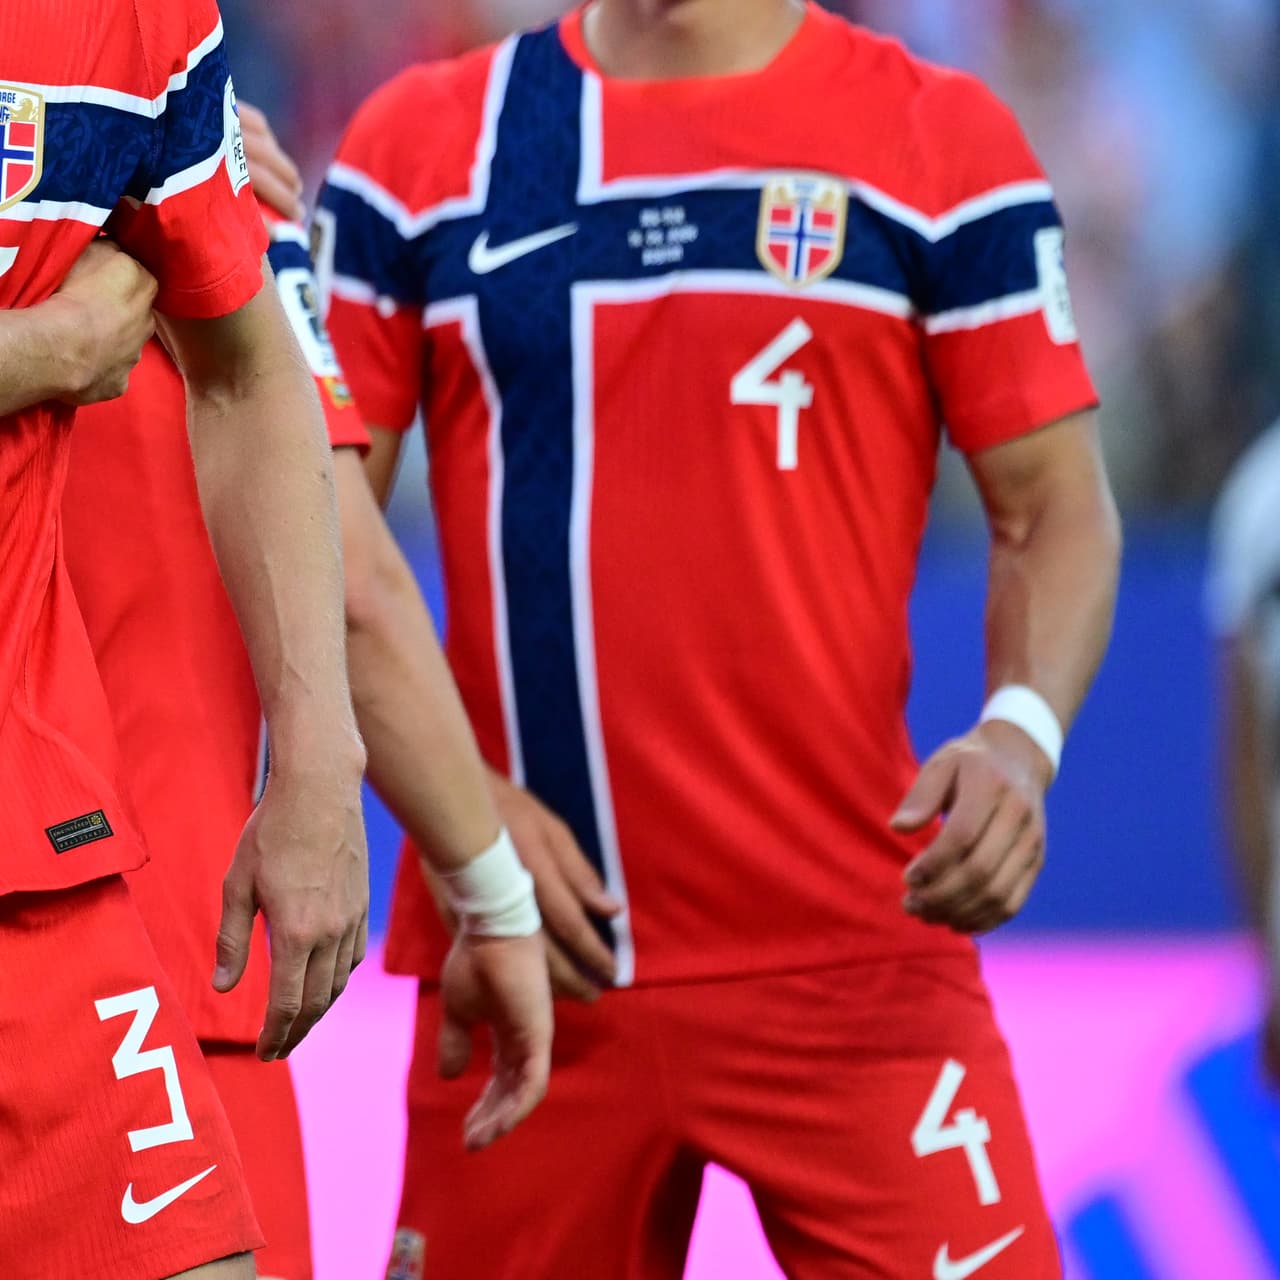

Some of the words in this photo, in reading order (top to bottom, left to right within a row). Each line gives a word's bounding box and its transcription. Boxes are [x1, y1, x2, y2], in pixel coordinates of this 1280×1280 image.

[730, 319, 813, 470] 4
[93, 985, 195, 1153] 3
[911, 1059, 1001, 1206] 4
